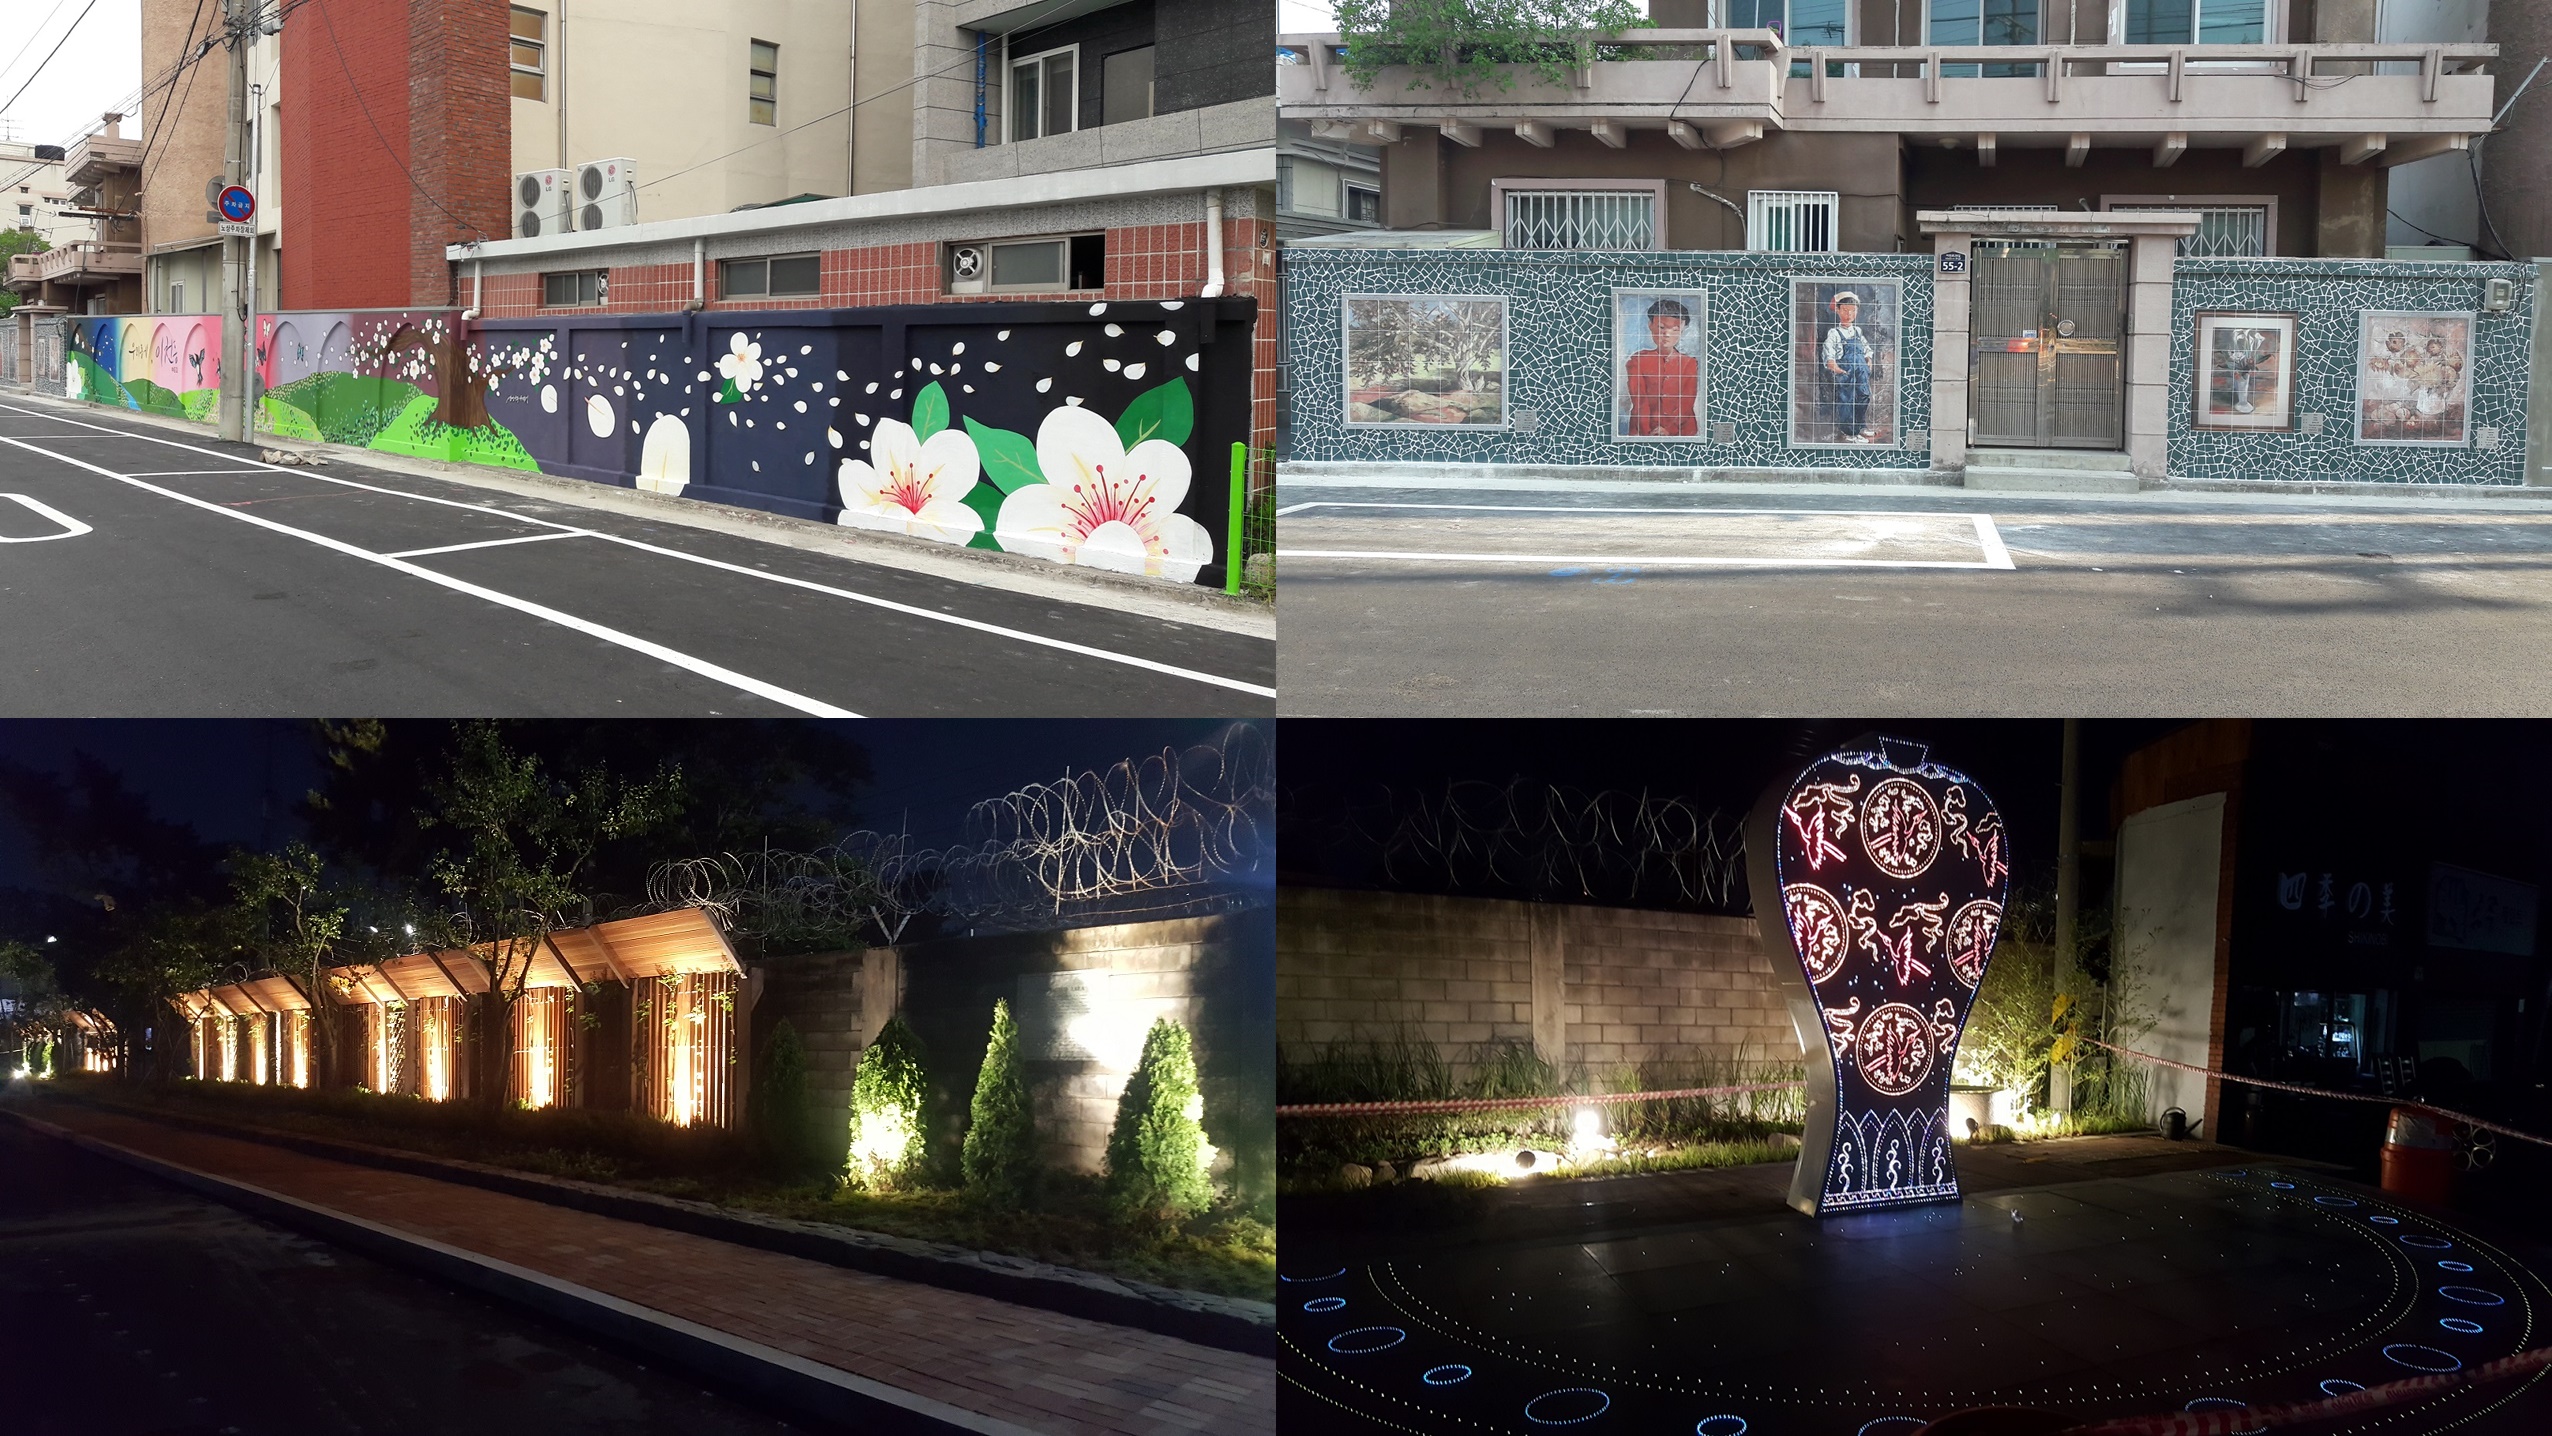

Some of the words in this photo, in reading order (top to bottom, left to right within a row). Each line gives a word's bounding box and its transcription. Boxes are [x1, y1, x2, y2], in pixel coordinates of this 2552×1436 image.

[224, 200, 250, 210] 주차금지
[1942, 261, 1964, 271] 55-2
[2278, 872, 2397, 926] 四季の美
